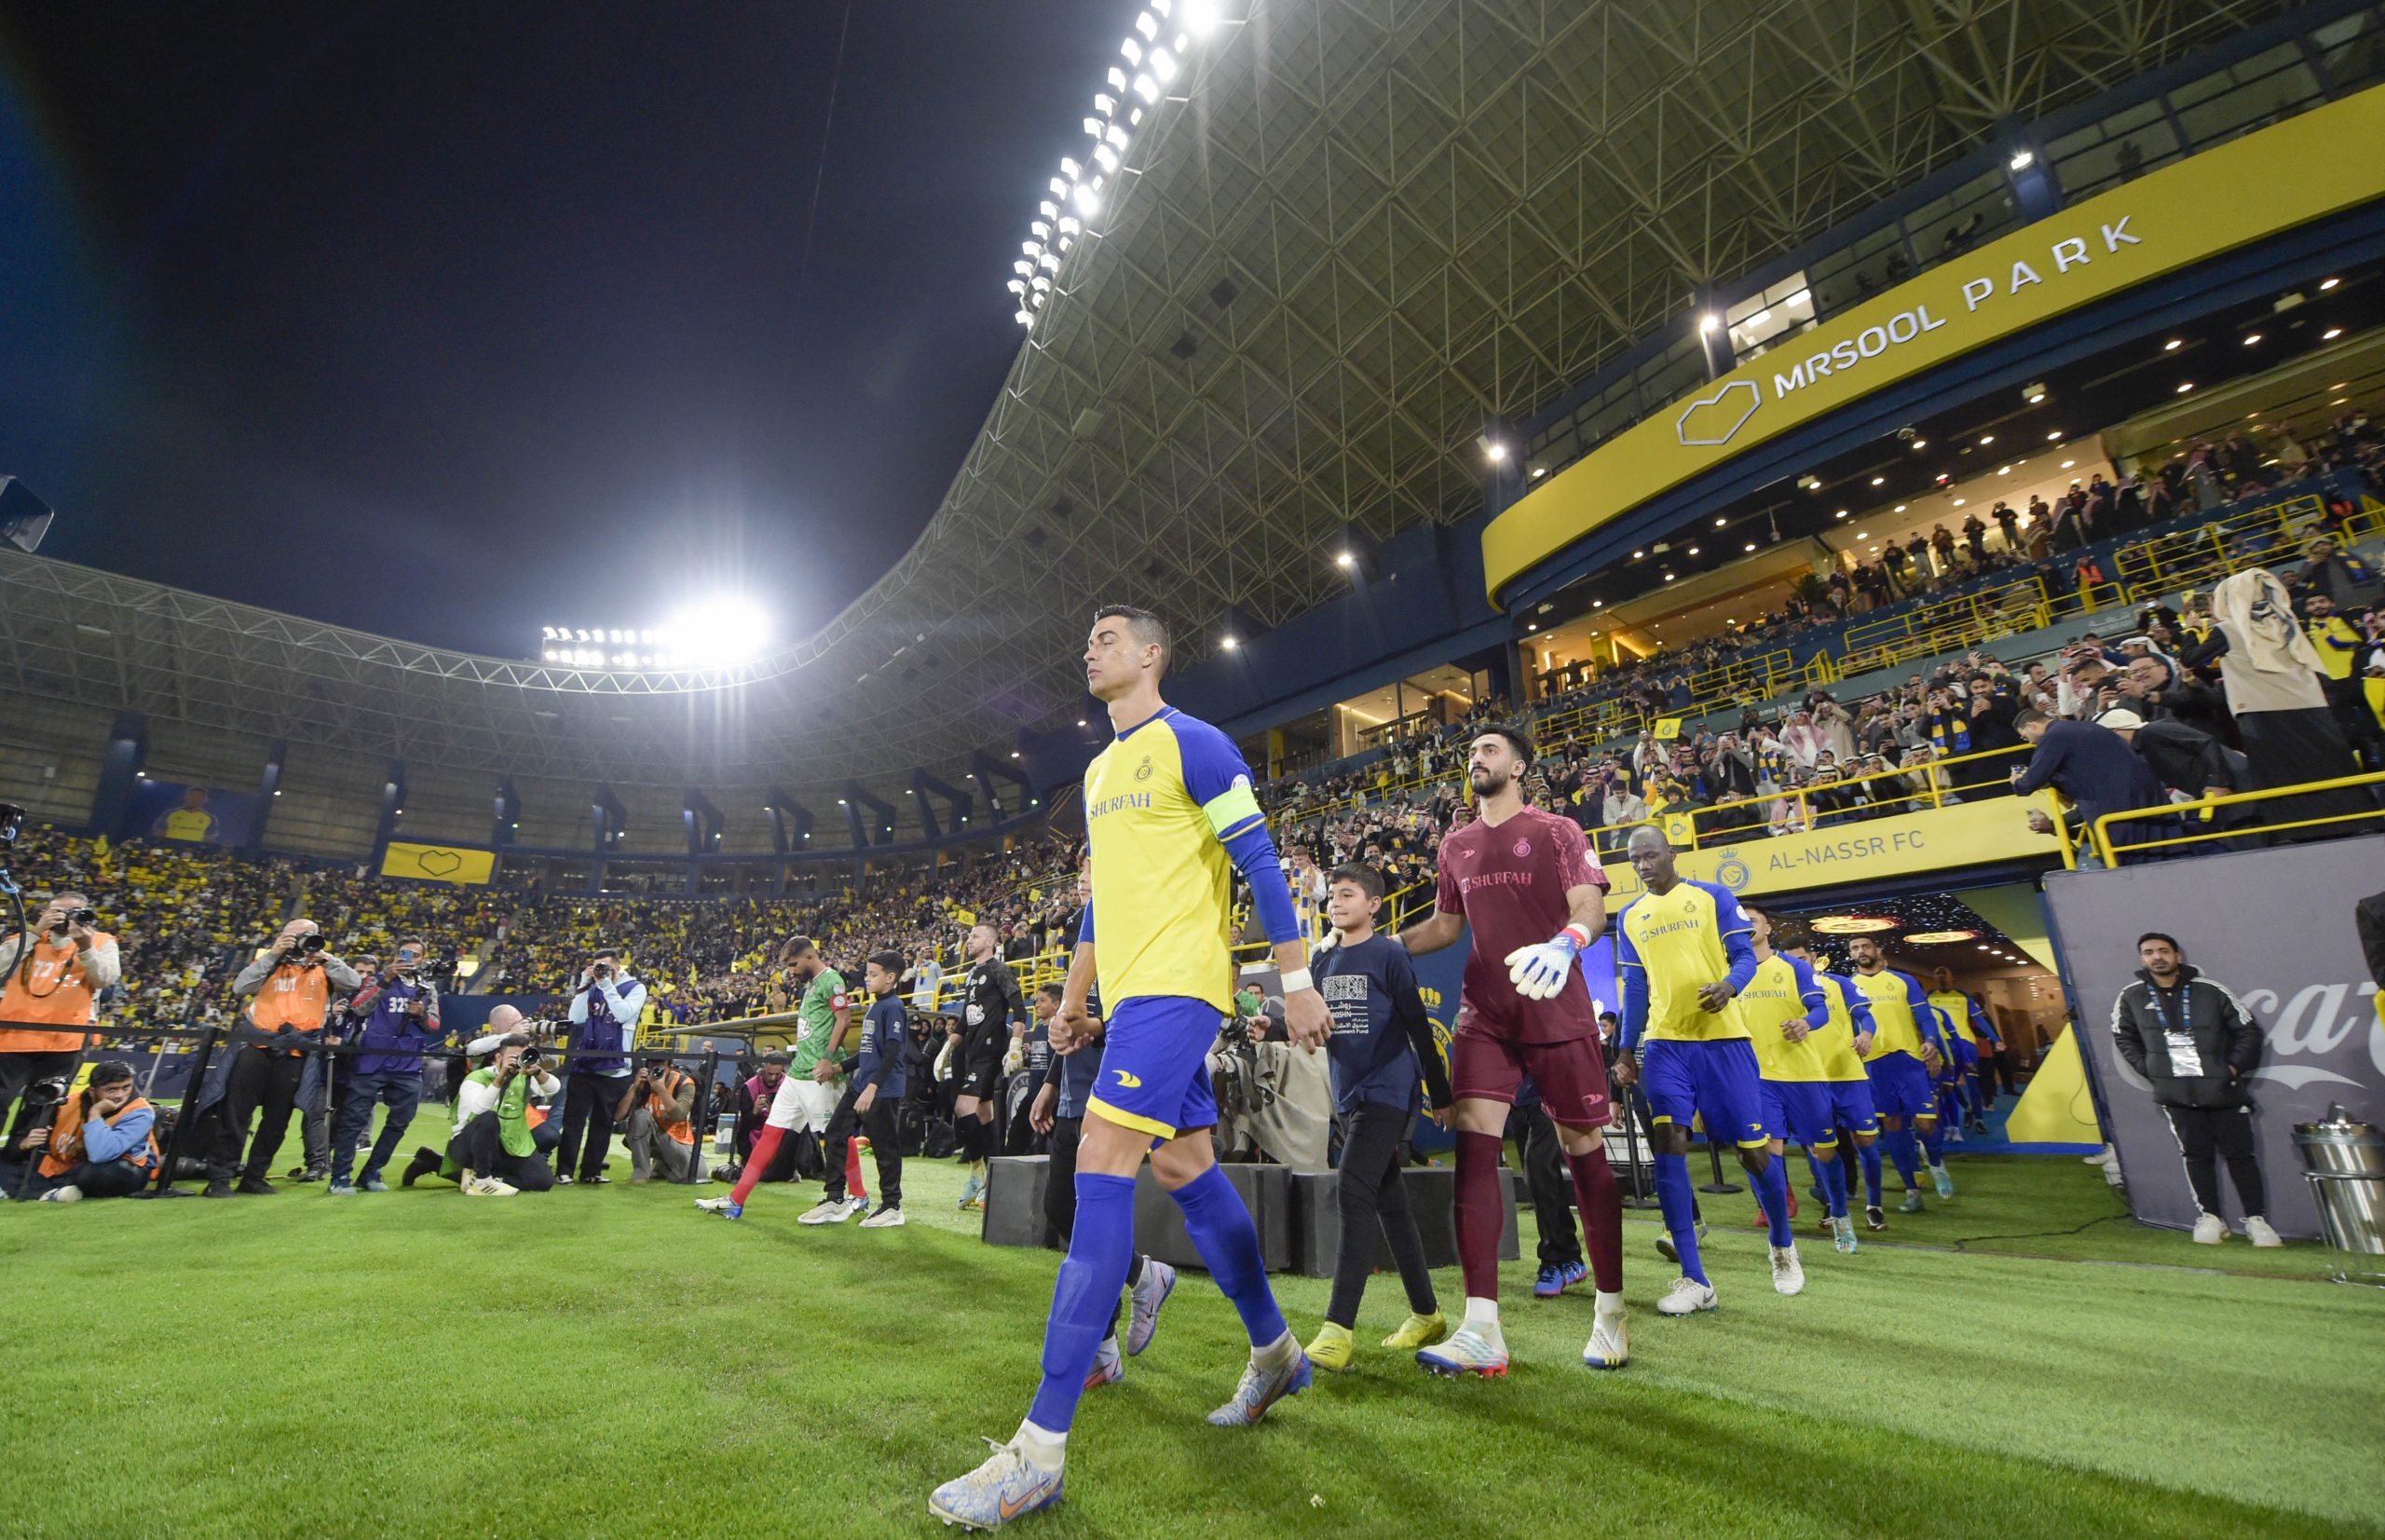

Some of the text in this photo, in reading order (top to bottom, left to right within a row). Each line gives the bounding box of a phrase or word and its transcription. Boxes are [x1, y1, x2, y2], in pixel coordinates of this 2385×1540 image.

[1773, 215, 2142, 400] MRSOOL PARK
[1089, 792, 1151, 821] SHURFAH
[1769, 837, 1886, 871] AL-NASSR
[1892, 830, 1925, 852] FC
[1471, 871, 1533, 889] SHURFAH
[1650, 920, 1700, 937] SHURFAH
[1743, 989, 1787, 1001] SHURFAH
[1432, 1026, 1448, 1049] SSR
